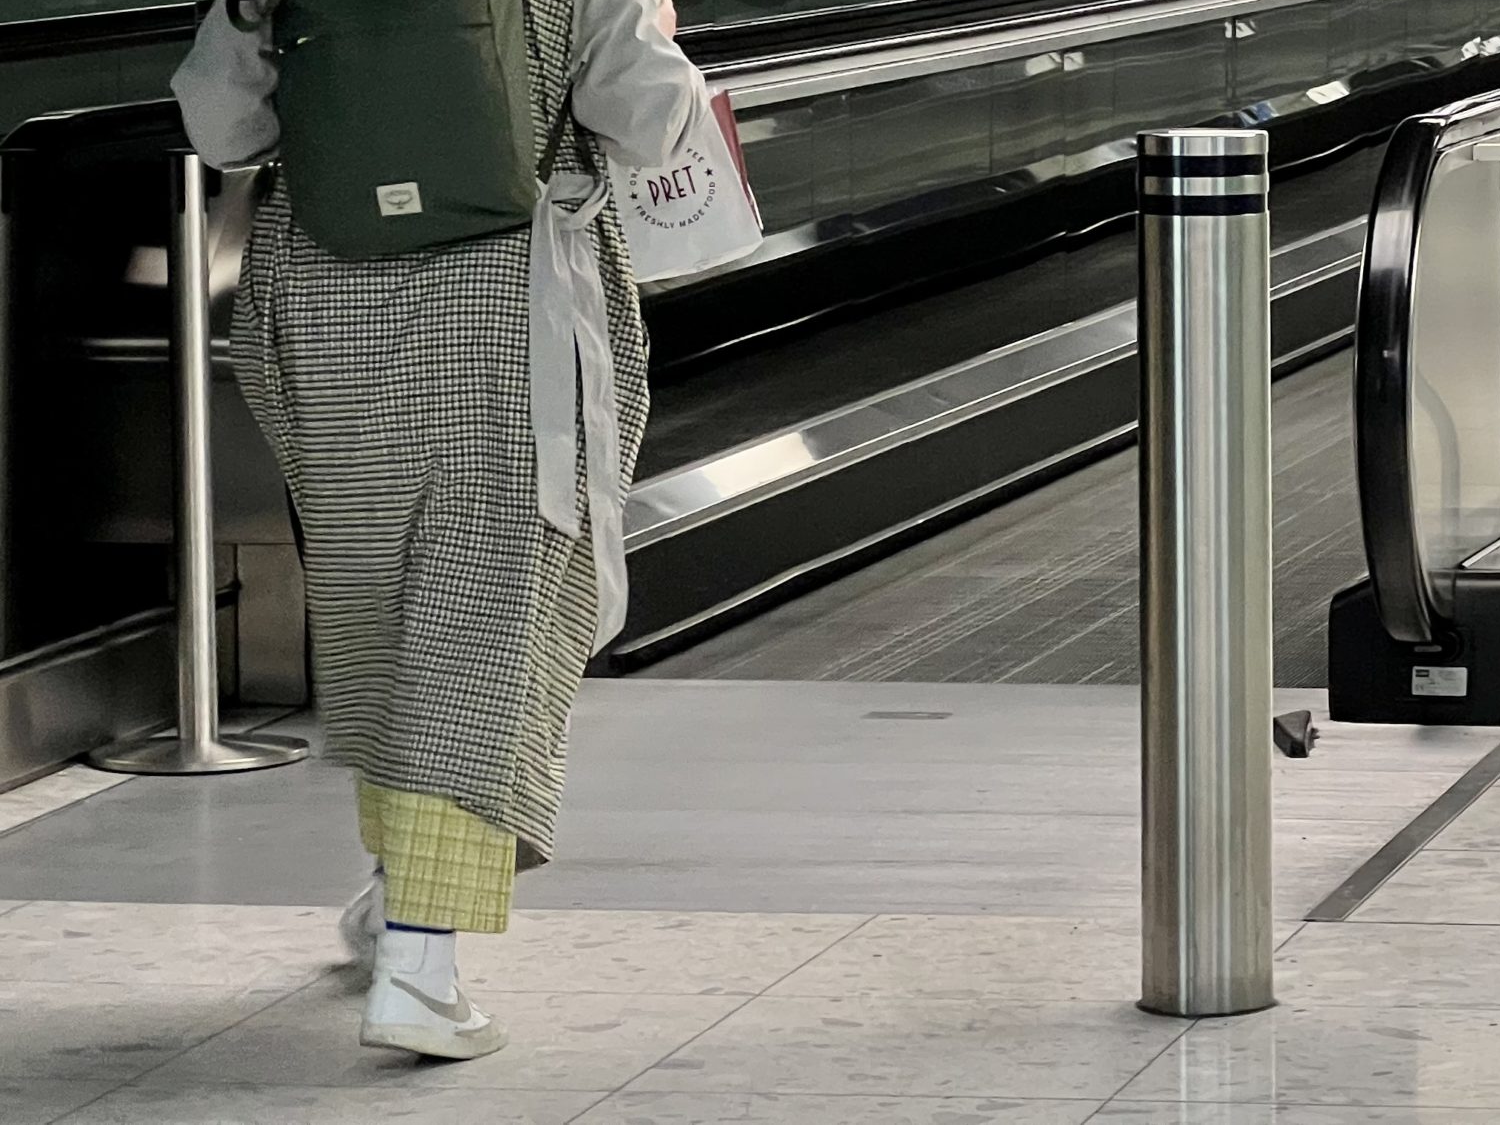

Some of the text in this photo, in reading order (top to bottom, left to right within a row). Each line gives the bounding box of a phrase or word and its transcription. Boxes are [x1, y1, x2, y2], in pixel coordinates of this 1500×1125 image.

[634, 181, 716, 229] FRESHLY MADE FOOD
[646, 165, 697, 207] PRET
